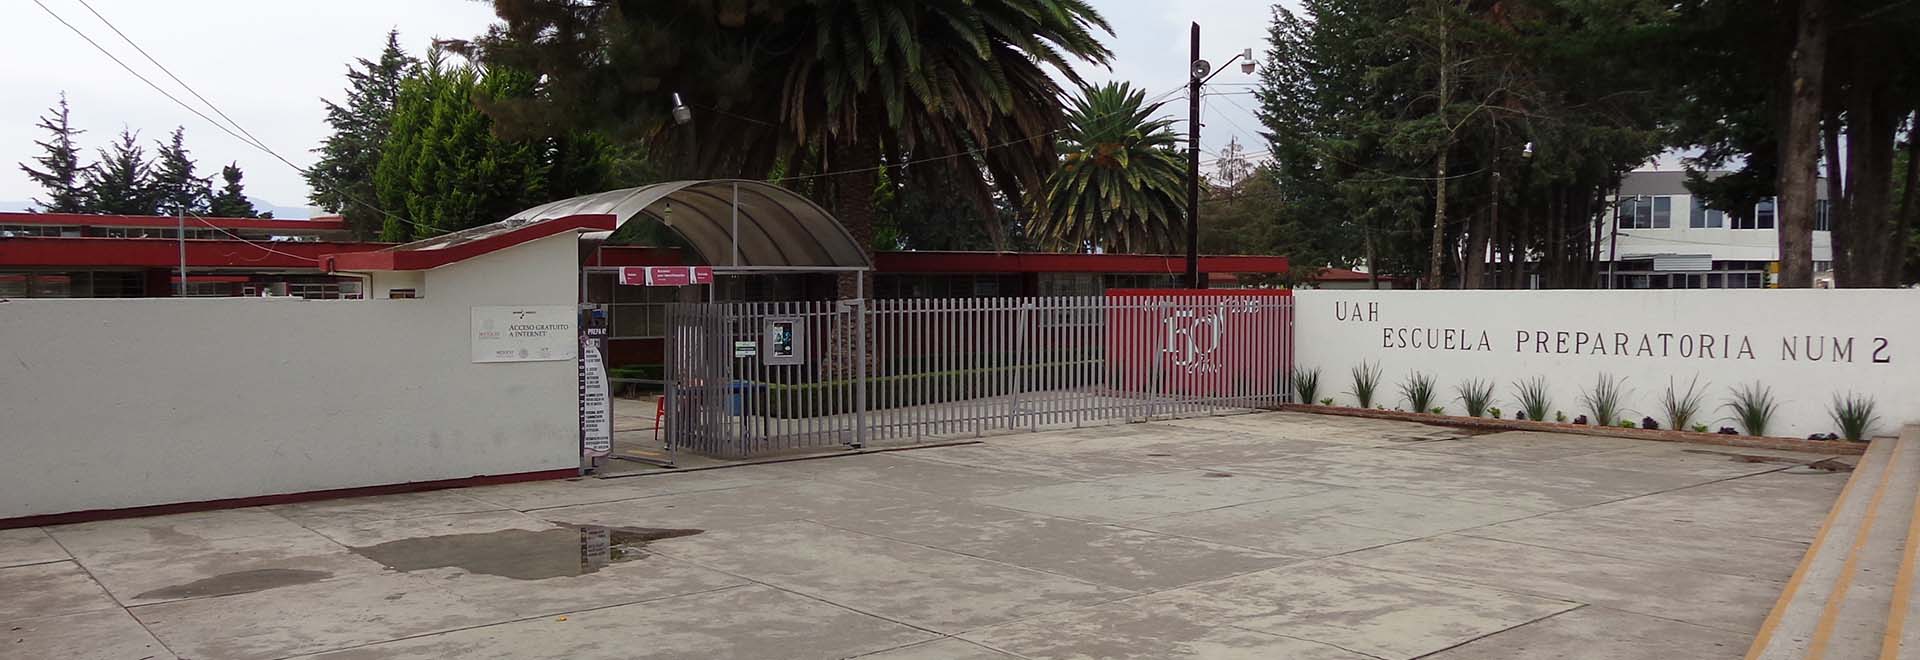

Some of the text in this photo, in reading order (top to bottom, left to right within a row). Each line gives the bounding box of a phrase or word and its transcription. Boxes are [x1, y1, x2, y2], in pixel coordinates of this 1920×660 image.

[1335, 300, 1379, 323] UAH
[1383, 327, 1891, 364] ESCUELA PREPARATORIA NUM 2
